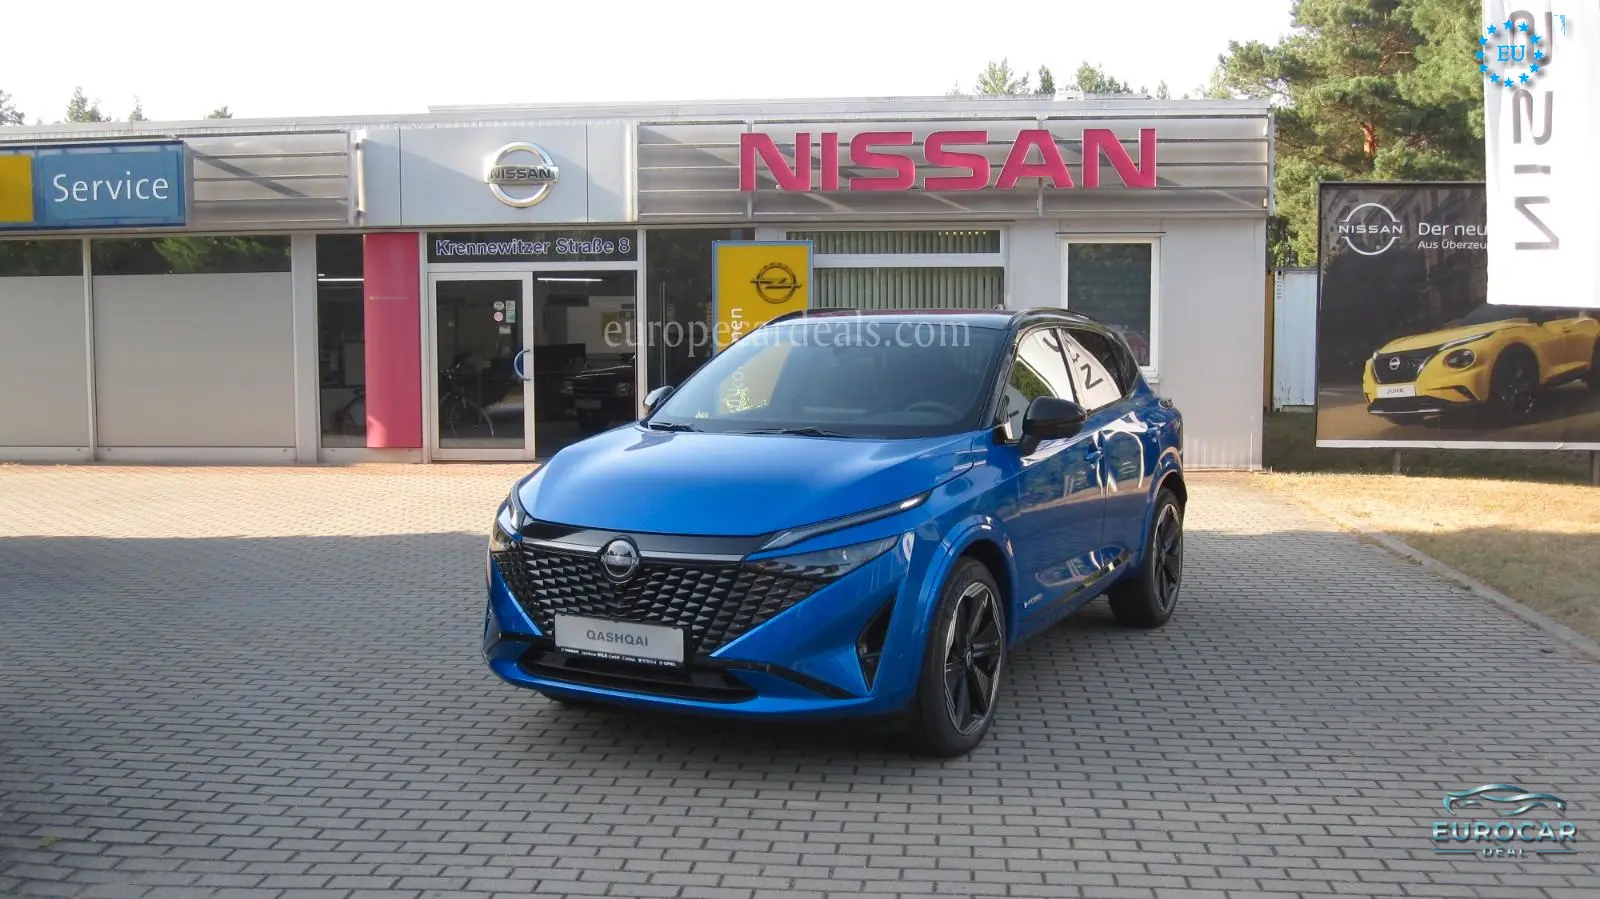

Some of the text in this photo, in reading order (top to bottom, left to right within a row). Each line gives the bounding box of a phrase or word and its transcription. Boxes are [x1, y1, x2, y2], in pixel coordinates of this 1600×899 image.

[740, 128, 1157, 192] NISSAN
[490, 168, 551, 179] NISSAN
[52, 170, 170, 203] Service
[1338, 225, 1403, 234] NISSAN
[1418, 222, 1449, 236] Der
[435, 237, 631, 256] Krennewitzer Straße 8
[1417, 240, 1439, 249] Aus
[586, 630, 649, 647] QASHQAI
